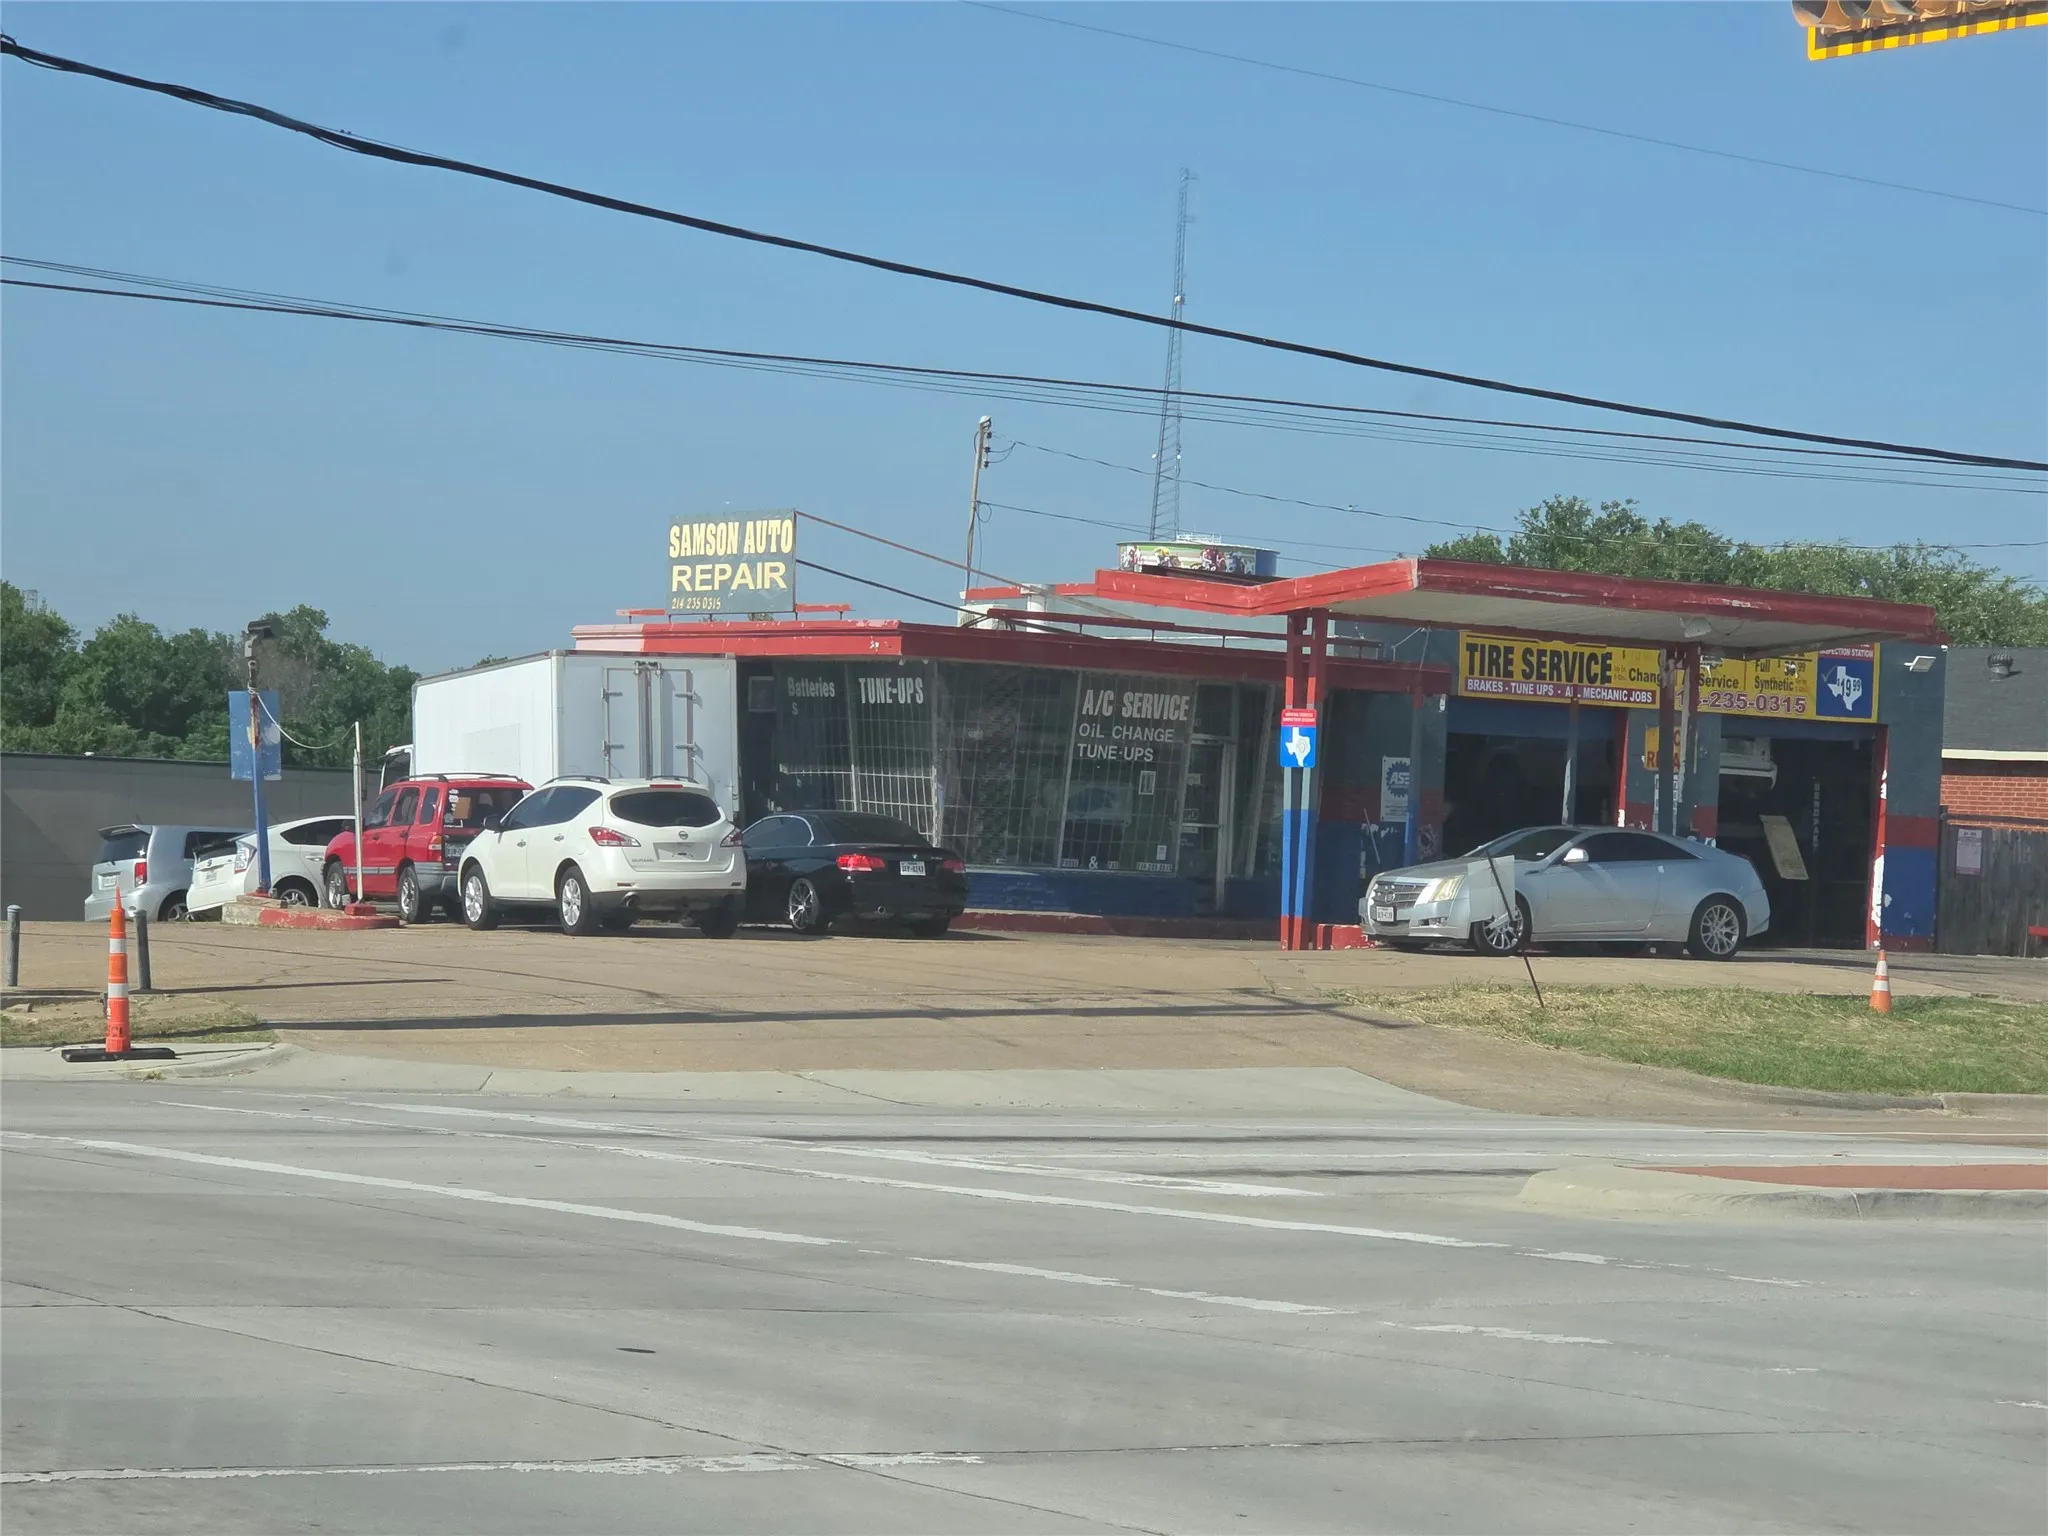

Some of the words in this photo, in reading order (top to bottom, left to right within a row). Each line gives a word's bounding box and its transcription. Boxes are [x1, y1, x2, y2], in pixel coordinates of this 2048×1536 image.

[669, 521, 740, 558] SAMSON
[744, 519, 793, 554] AUTO
[671, 561, 787, 592] REPAIR
[671, 597, 684, 609] 214
[686, 597, 700, 609] 235
[702, 596, 721, 610] 0315
[1852, 648, 1874, 658] STATION
[1465, 643, 1515, 679] TIRE
[1521, 647, 1612, 685] SERVICE
[1755, 659, 1771, 673] Full
[1628, 668, 1663, 687] Chang
[1699, 673, 1739, 689] Service
[1754, 675, 1794, 693] Synthetic
[787, 677, 836, 698] Batteries
[858, 677, 924, 705] TUNE-UPS
[1467, 679, 1504, 693] BRAKES
[1510, 682, 1535, 695] TUNE
[1536, 684, 1554, 696] UPS
[1583, 687, 1628, 702] MECHANIC
[1629, 689, 1653, 703] JOBS
[1082, 689, 1115, 717] A/C
[1121, 691, 1190, 721] SERVICE
[1112, 725, 1175, 743] CHANGE
[1077, 743, 1154, 762] TUNE-UPS
